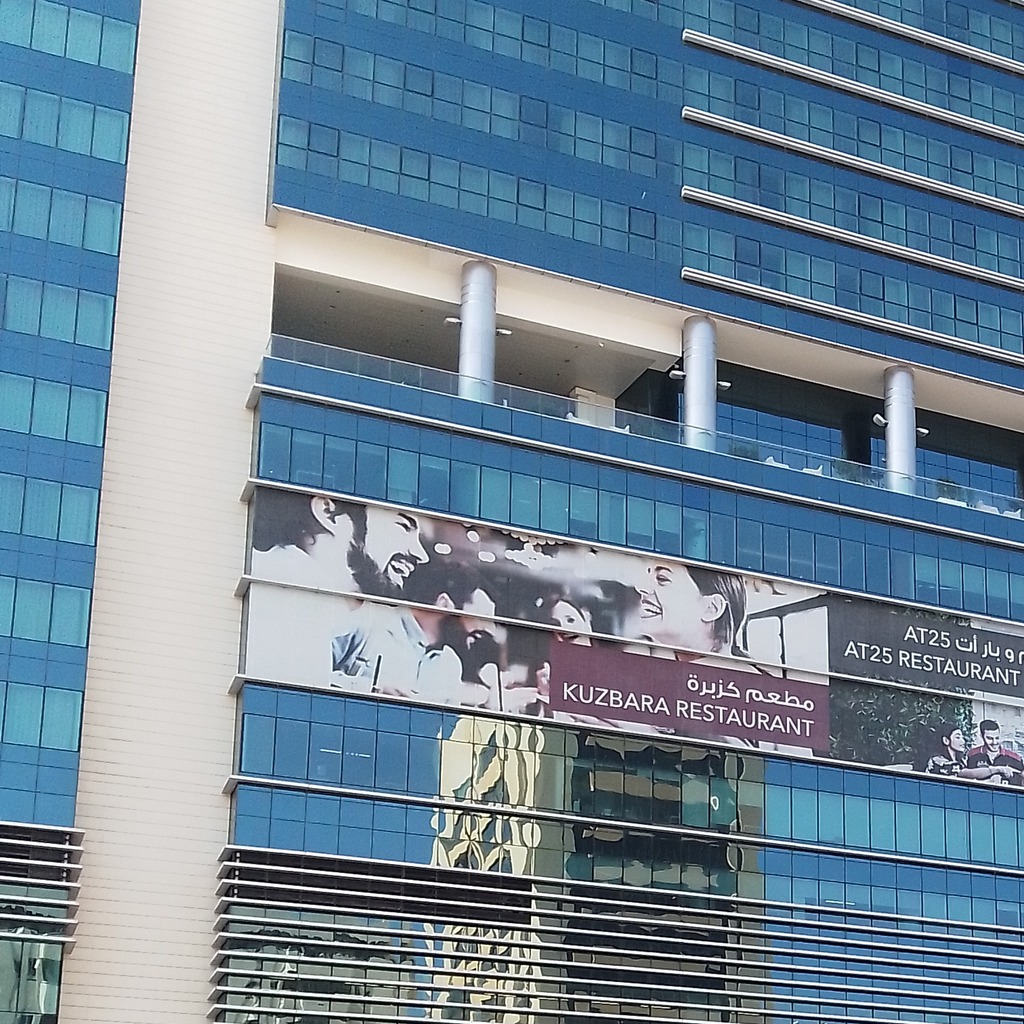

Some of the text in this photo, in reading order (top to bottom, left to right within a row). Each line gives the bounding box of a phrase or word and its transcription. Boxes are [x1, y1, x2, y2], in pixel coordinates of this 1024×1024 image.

[904, 625, 950, 649] AT25
[982, 641, 1001, 663] بار
[843, 640, 893, 665] AT25
[898, 650, 1021, 686] RESTAURANT
[1005, 648, 1015, 663] و
[686, 673, 814, 712] مطعم كزبرة
[563, 682, 815, 737] KUZBARA RESTAURANT
